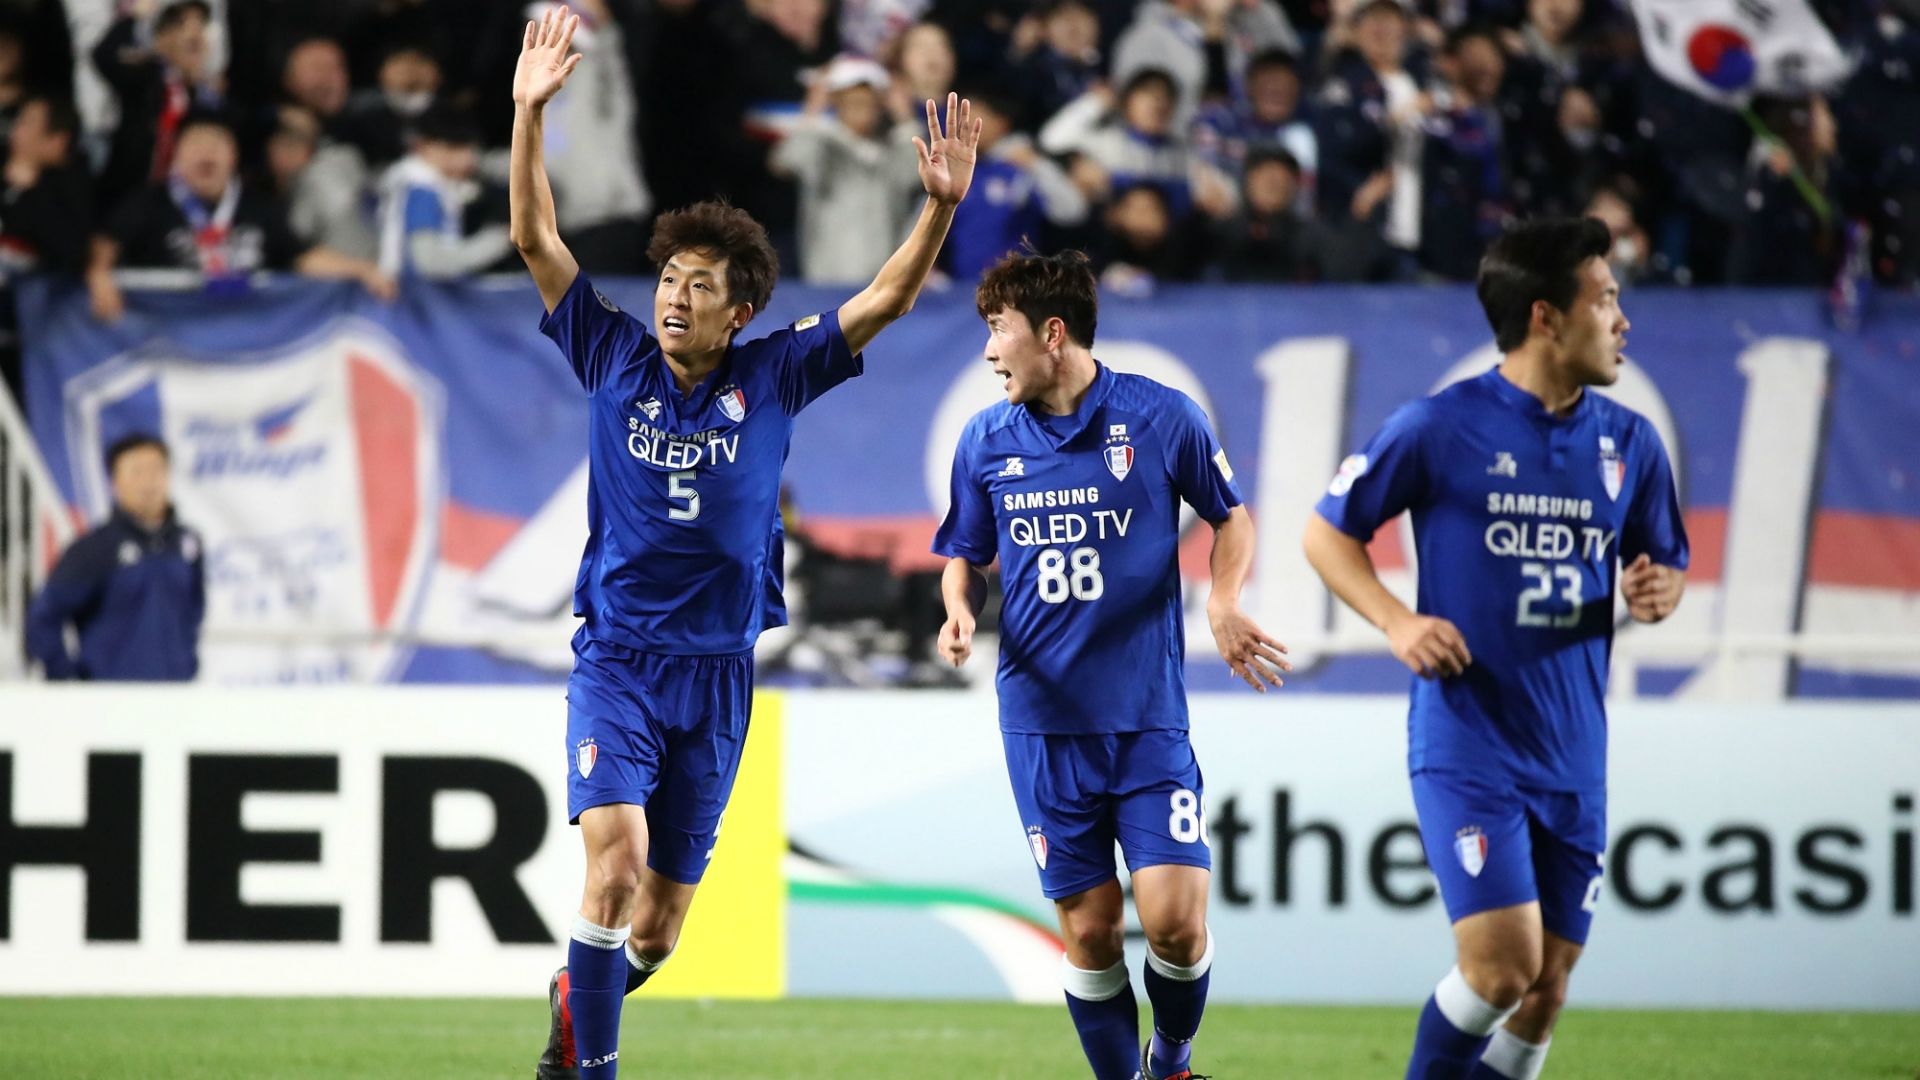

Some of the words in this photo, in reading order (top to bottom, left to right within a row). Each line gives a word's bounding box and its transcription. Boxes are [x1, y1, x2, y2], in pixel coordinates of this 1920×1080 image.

[628, 432, 702, 469] QLED
[707, 434, 739, 466] TV
[668, 470, 700, 522] 5
[1003, 486, 1099, 511] SAMSUNG
[1487, 492, 1593, 520] SAMSUNG
[1010, 513, 1088, 547] QLED
[1092, 508, 1133, 540] TV
[1485, 520, 1575, 560] QLED
[1581, 526, 1617, 562] TV
[1038, 546, 1104, 604] 88
[1516, 562, 1584, 628] 23
[1211, 790, 1437, 909] the
[1609, 793, 1914, 915] casi
